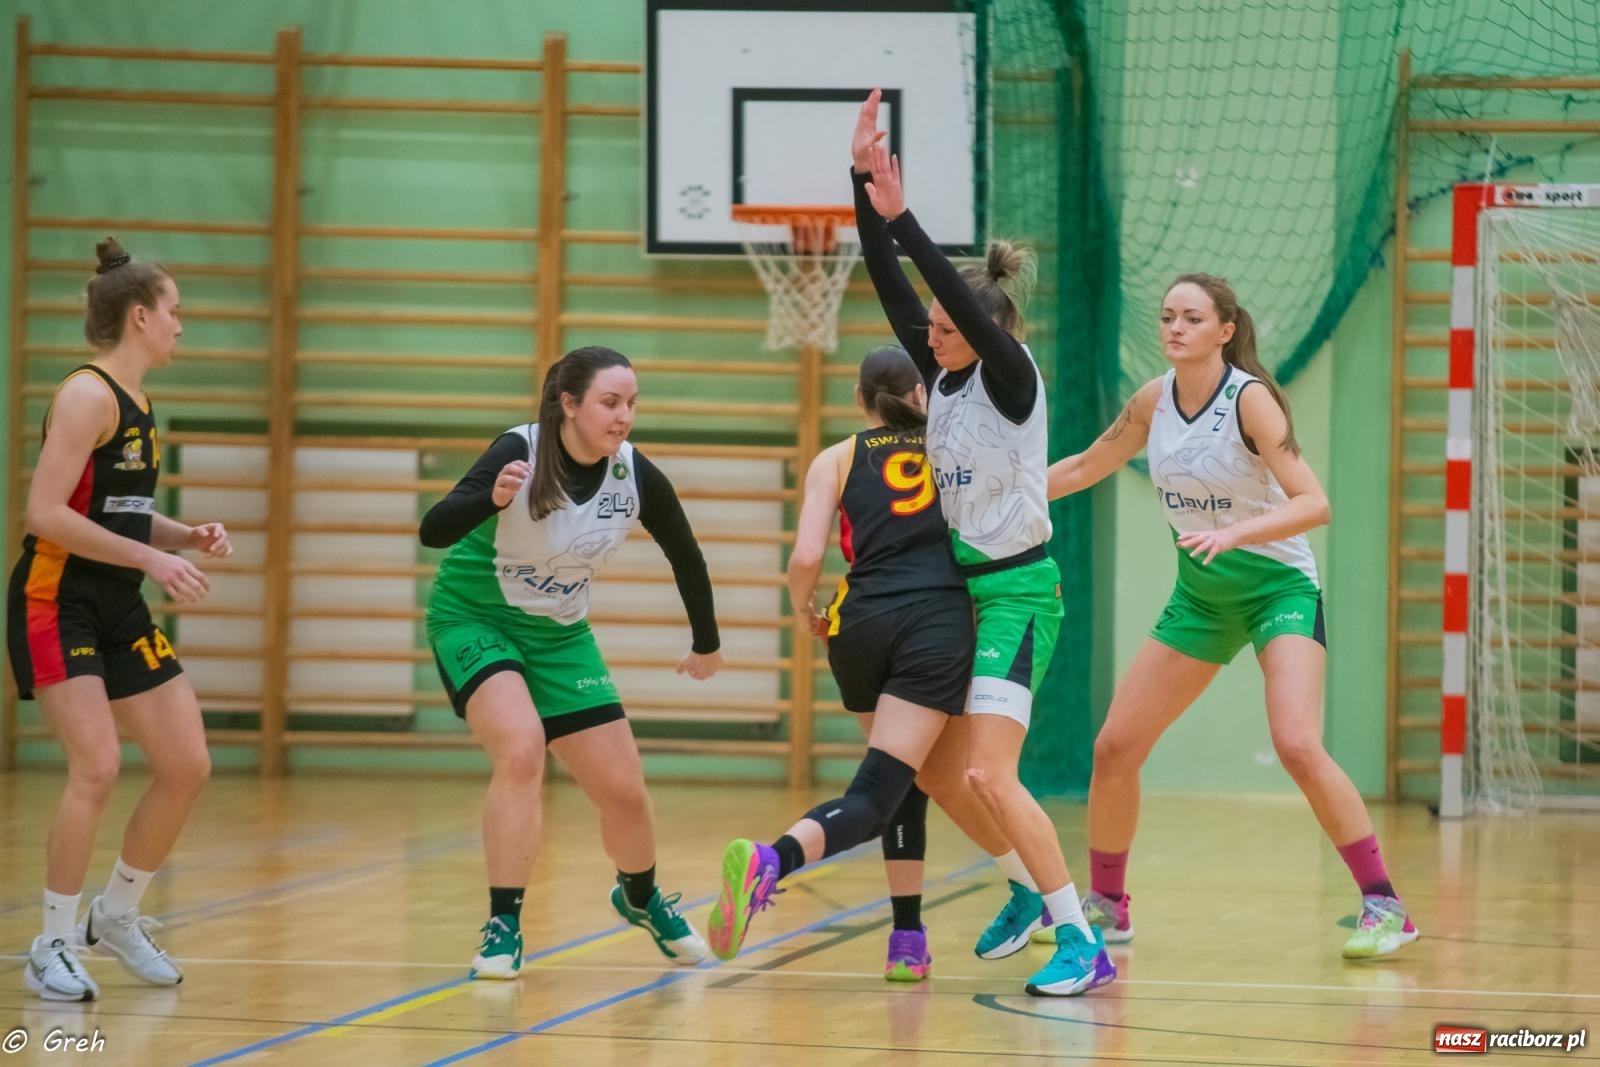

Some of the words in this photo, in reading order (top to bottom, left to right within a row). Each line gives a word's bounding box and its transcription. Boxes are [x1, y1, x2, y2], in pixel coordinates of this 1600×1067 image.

[1212, 407, 1230, 432] 7
[881, 449, 937, 516] 9
[597, 492, 635, 518] 24
[1165, 491, 1232, 511] Clavis
[524, 575, 589, 595] Clavi
[131, 627, 177, 671] 14
[456, 635, 508, 672] 24
